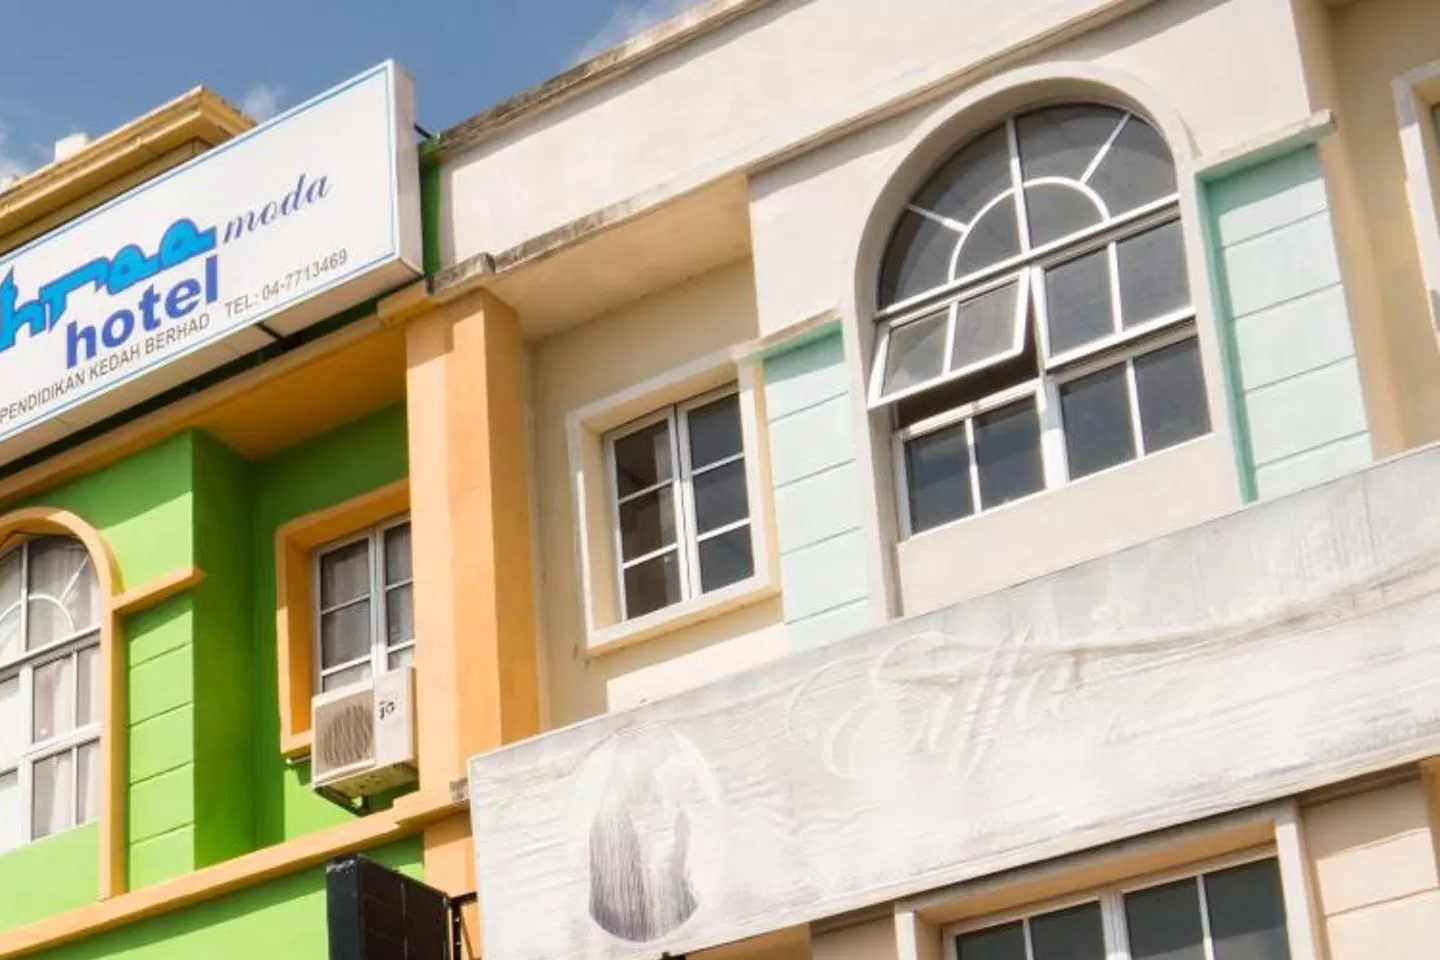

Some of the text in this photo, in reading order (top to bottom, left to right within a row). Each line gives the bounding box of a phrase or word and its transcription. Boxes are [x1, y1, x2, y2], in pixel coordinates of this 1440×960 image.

[222, 173, 332, 246] moda
[0, 365, 86, 422] PENDIDIKAN
[90, 342, 141, 382] KEDAH
[145, 311, 211, 354] BERHAD
[224, 291, 259, 318] TEL:
[261, 247, 348, 302] 04-7713469
[67, 254, 218, 369] hotel
